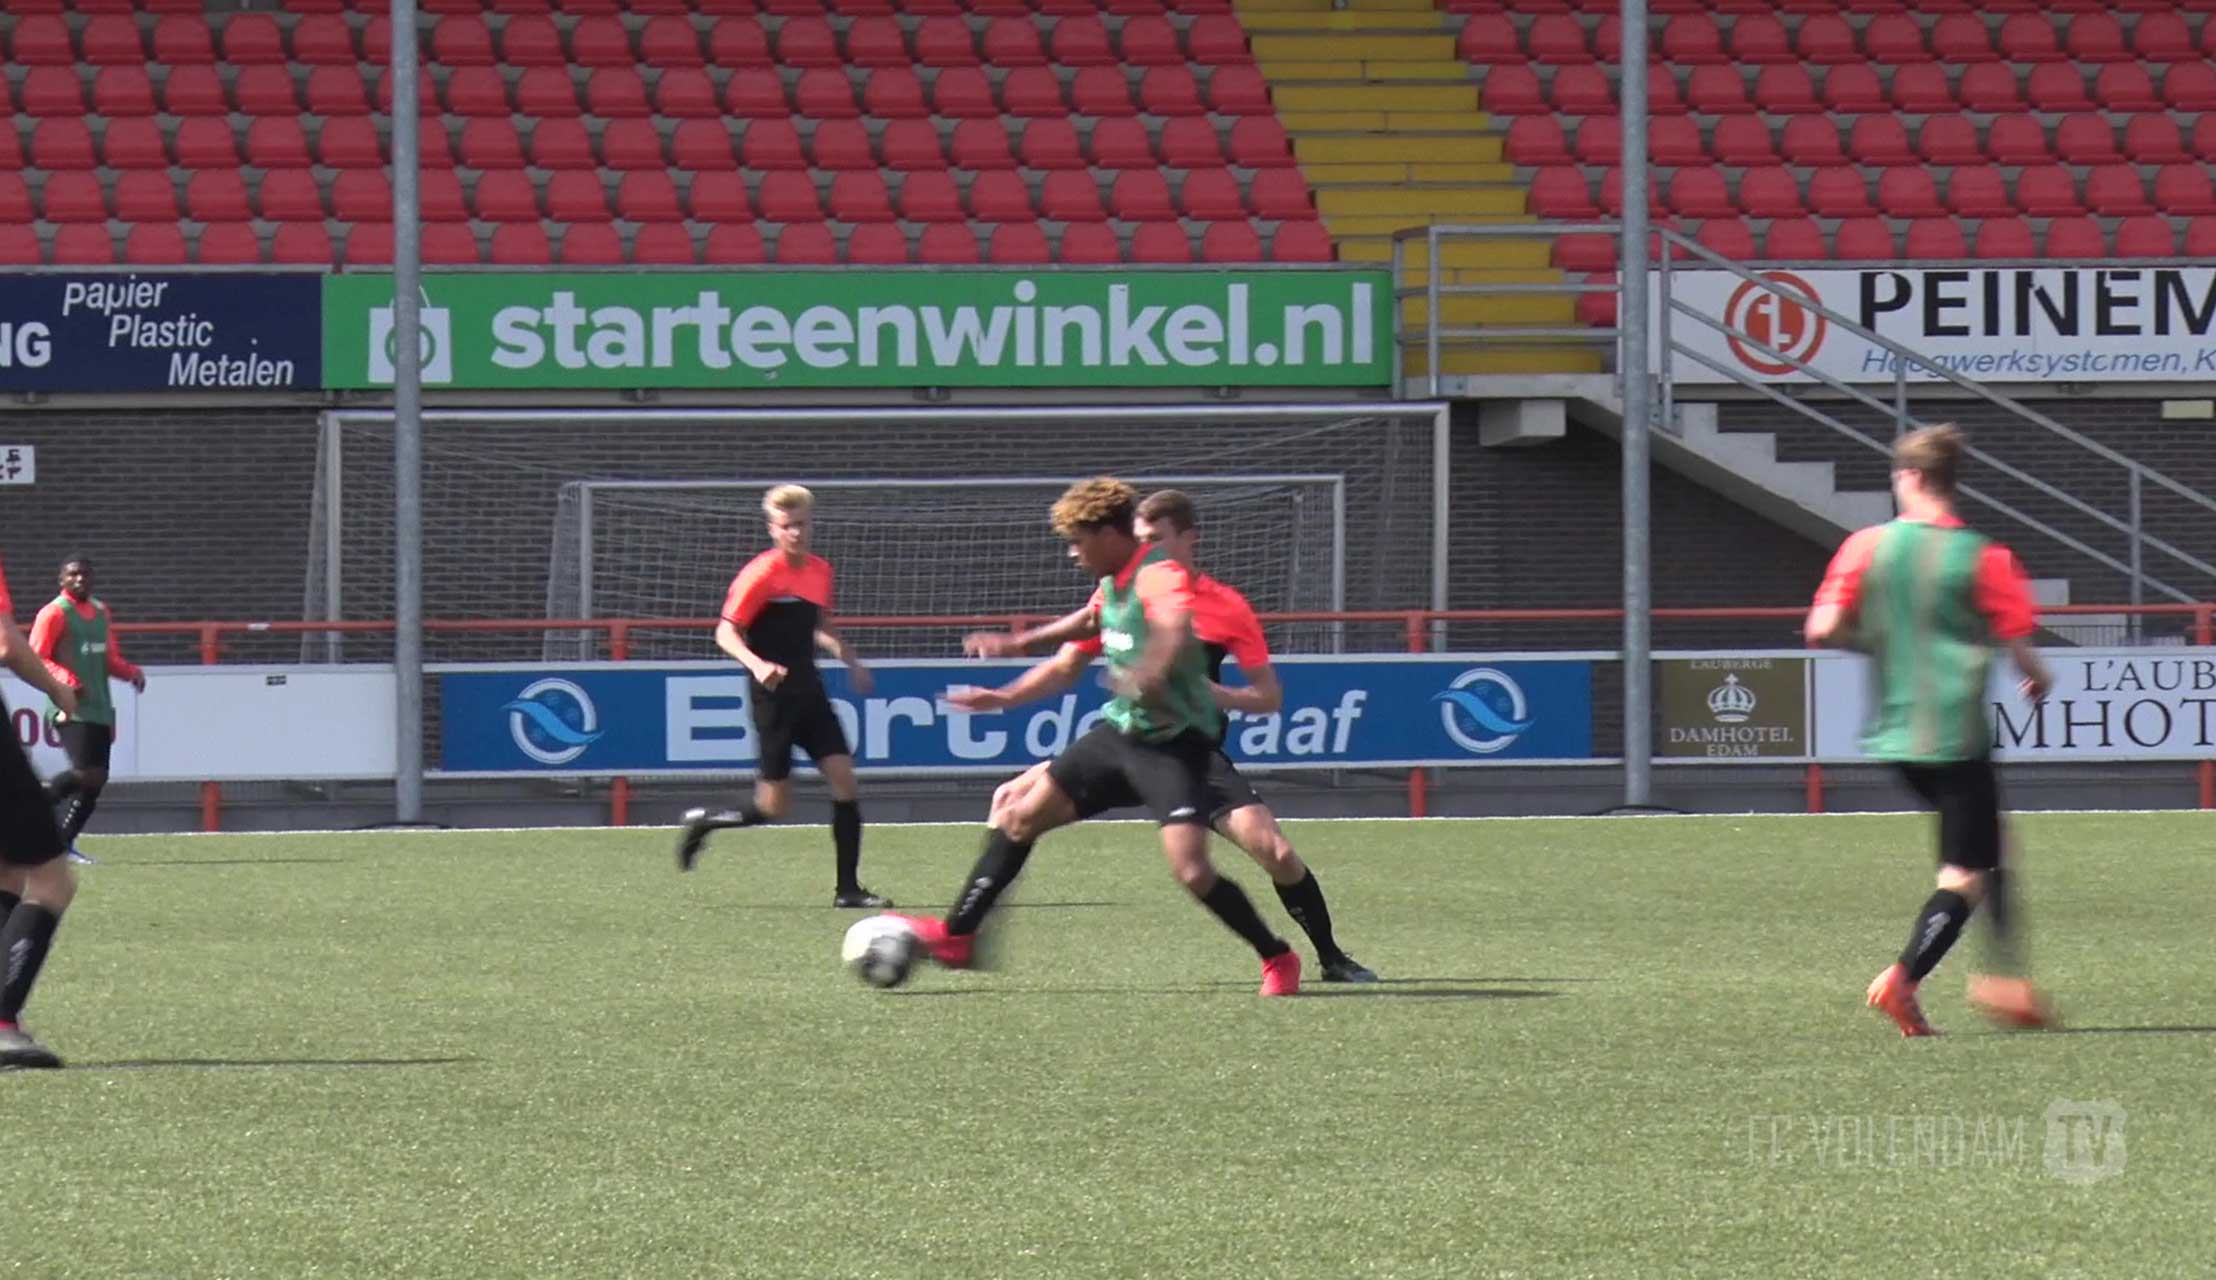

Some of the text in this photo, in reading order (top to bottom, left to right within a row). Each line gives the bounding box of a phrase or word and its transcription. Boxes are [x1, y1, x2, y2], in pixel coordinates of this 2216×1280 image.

[1859, 270, 2216, 337] PEINEM
[108, 313, 214, 347] Plastic
[490, 279, 1374, 370] starteenwinkel.nl
[168, 352, 294, 386] Metalen
[1669, 726, 1795, 743] DAMHOTEL
[1706, 743, 1760, 758] EDAM
